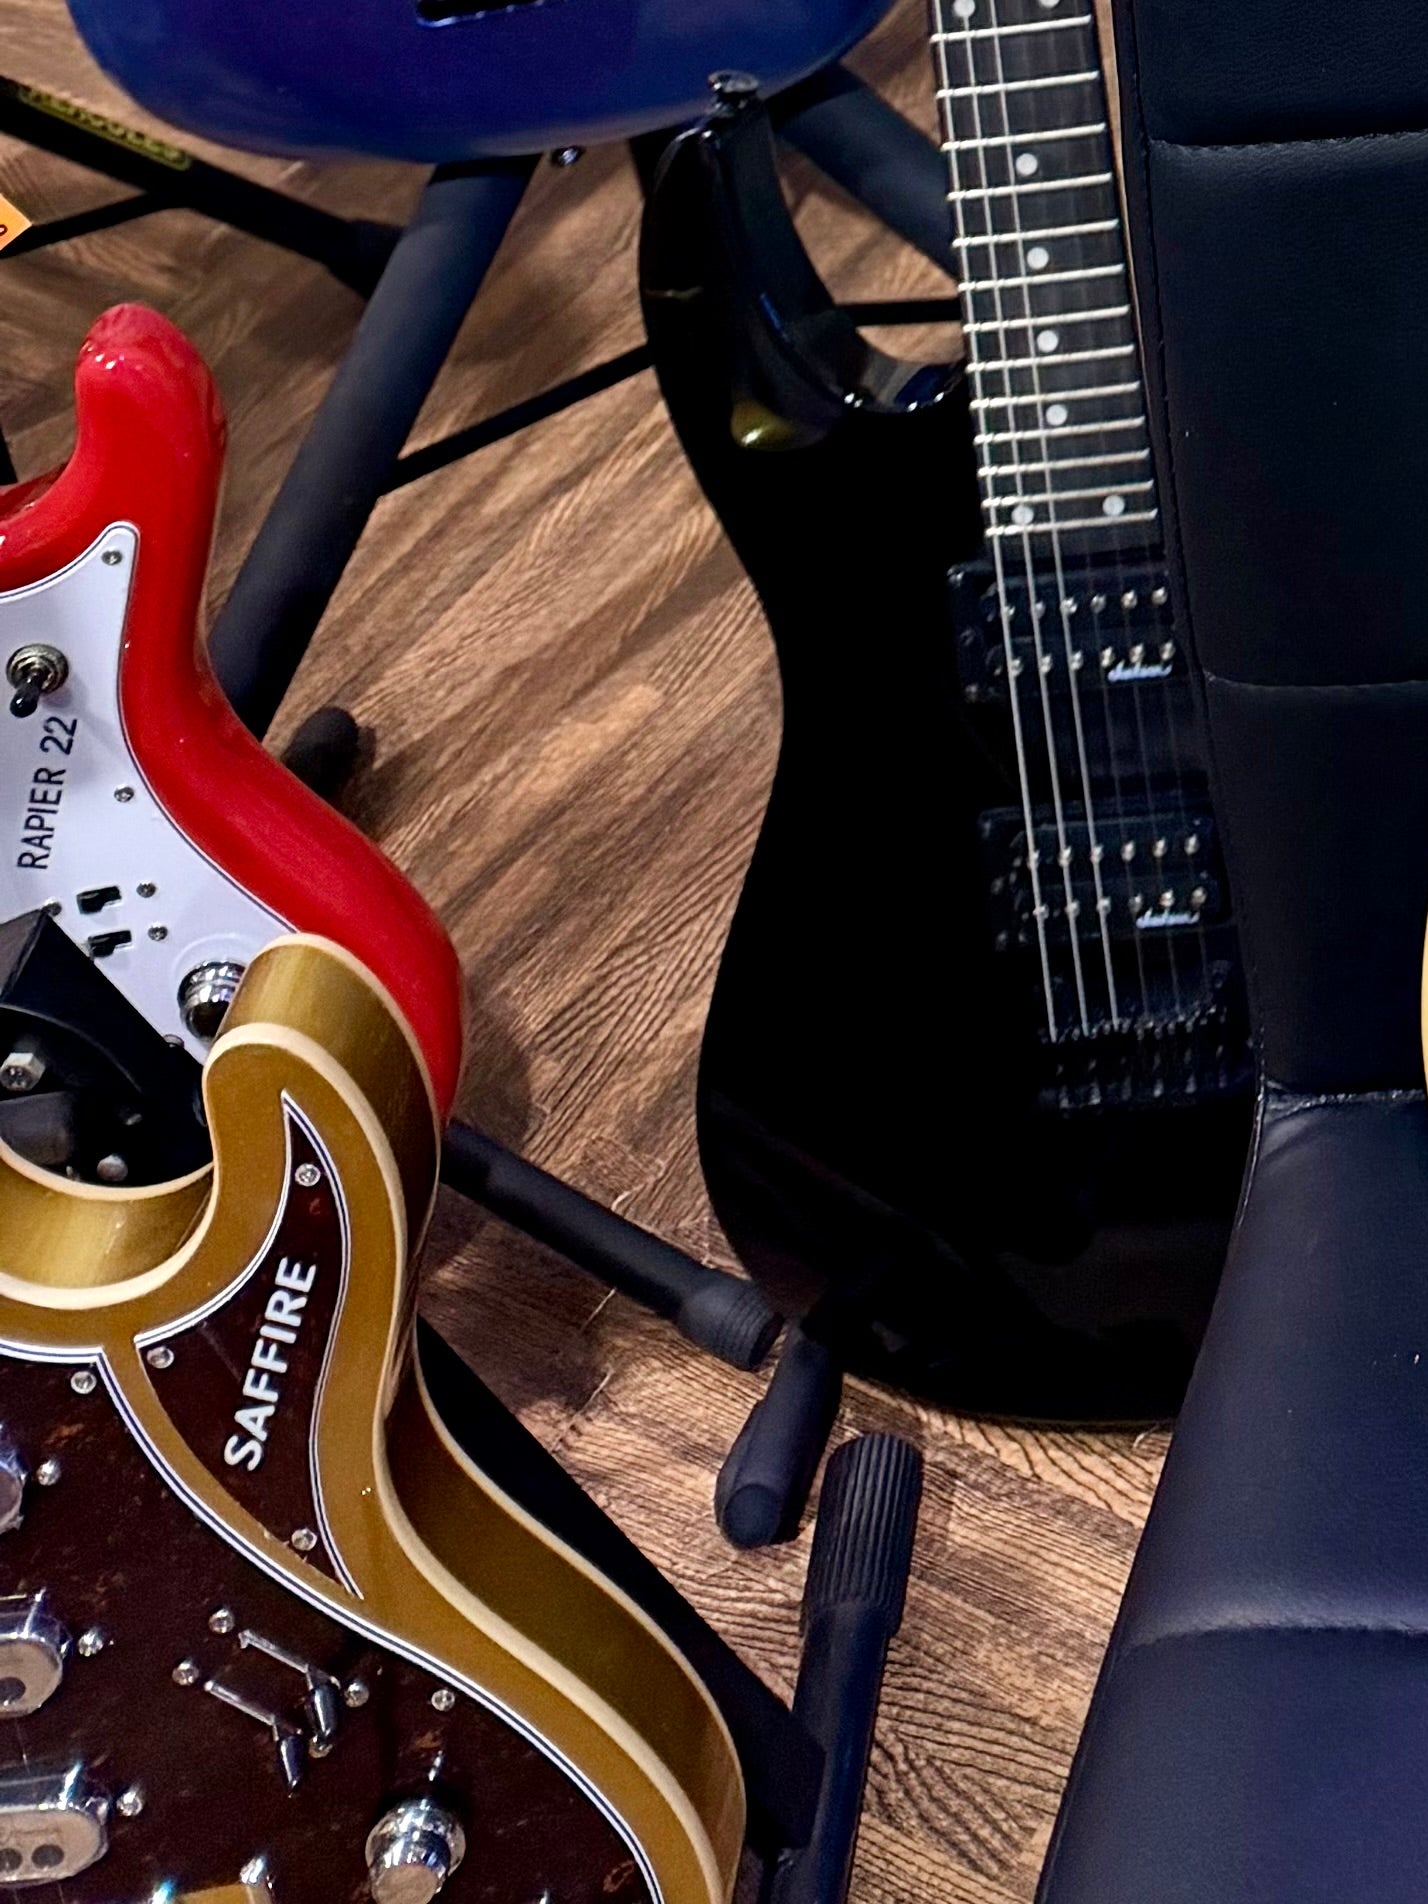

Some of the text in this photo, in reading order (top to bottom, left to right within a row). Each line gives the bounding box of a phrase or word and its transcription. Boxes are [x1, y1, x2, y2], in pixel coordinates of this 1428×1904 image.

[16, 716, 78, 870] RAPIER 22
[223, 1256, 317, 1472] SAFFIRE
